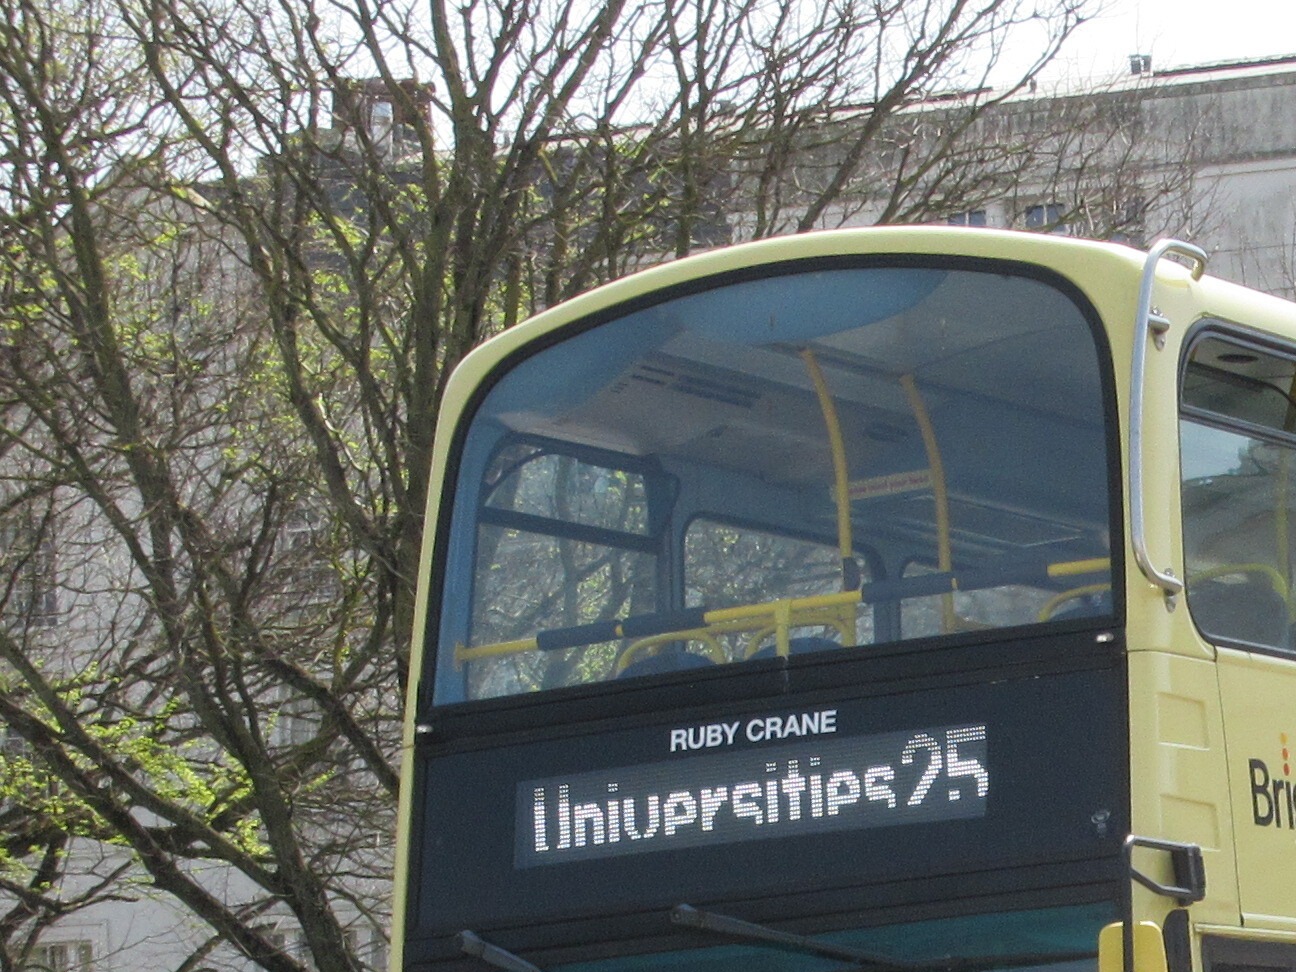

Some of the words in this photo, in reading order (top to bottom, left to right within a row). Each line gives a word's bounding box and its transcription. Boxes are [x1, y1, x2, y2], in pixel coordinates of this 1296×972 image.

[670, 719, 742, 752] RUBY
[745, 709, 838, 743] CRANE
[900, 724, 990, 806] 25
